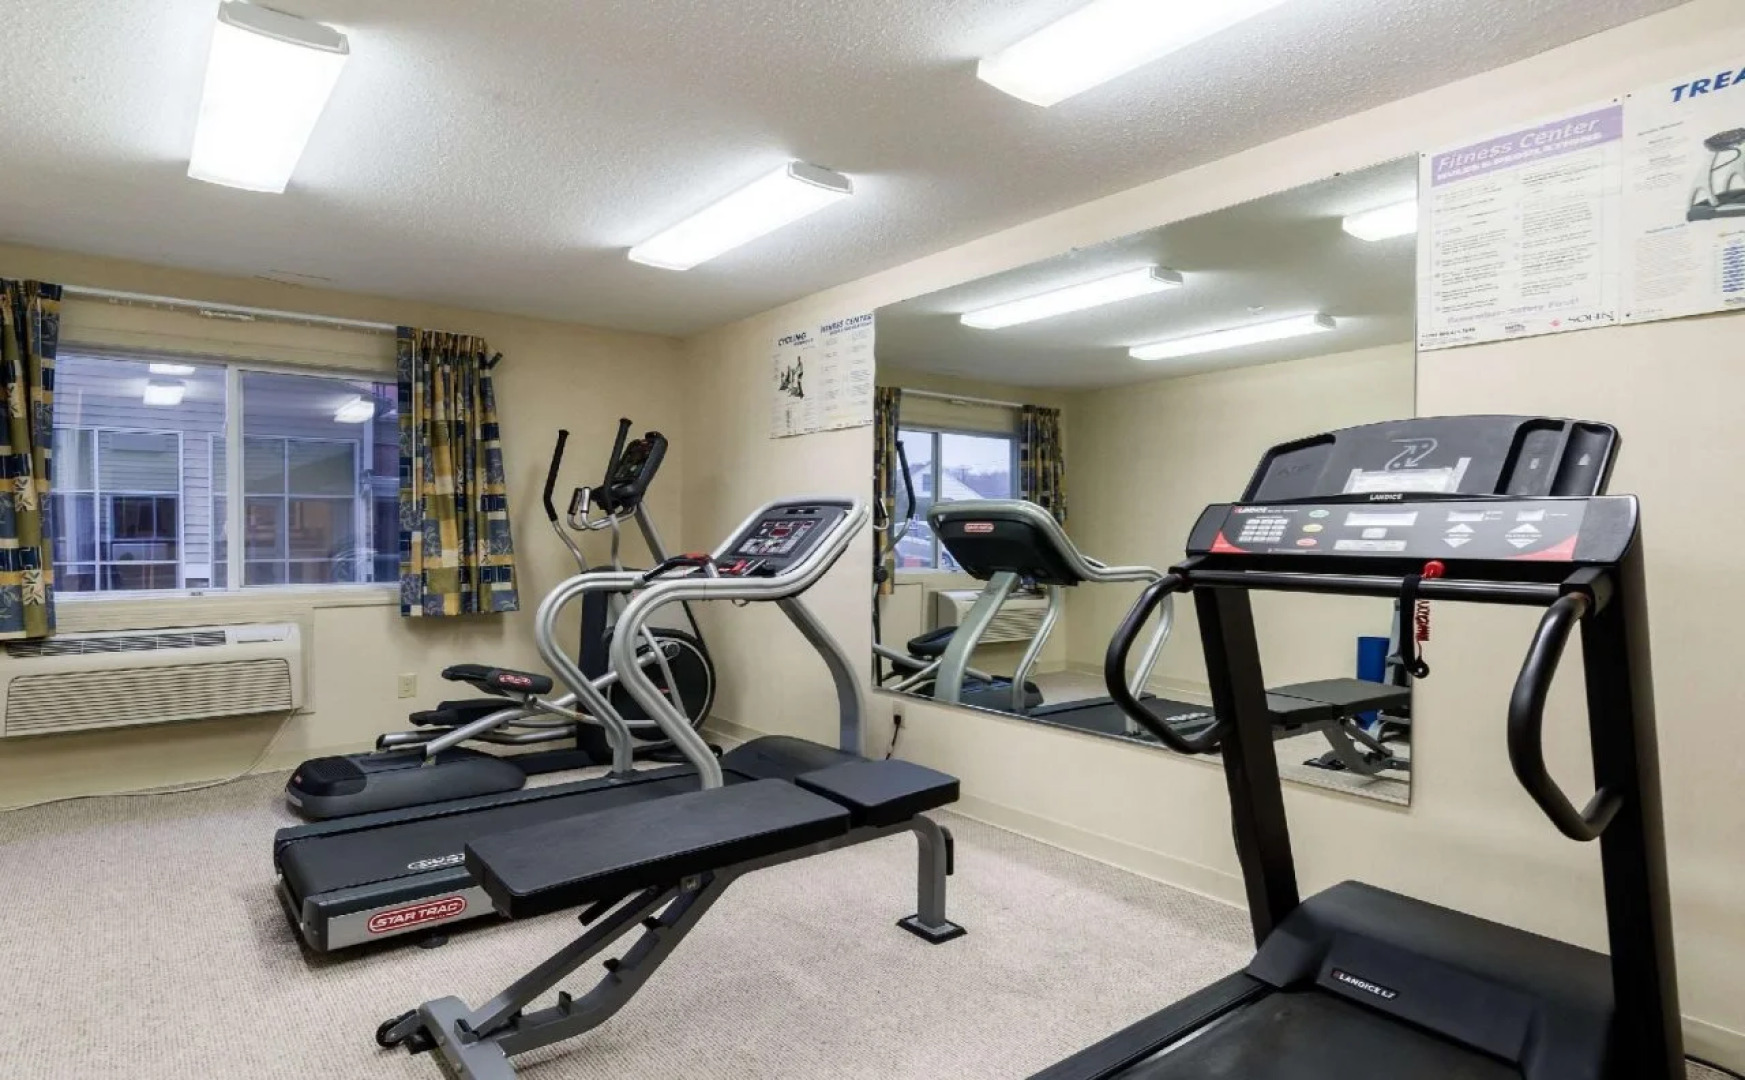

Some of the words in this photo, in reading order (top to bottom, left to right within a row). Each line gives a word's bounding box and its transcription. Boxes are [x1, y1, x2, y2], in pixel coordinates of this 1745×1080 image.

[1439, 142, 1512, 171] Fitness
[1519, 119, 1599, 148] Center
[1370, 493, 1403, 501] LANDICE
[377, 912, 416, 927] STAR
[418, 904, 458, 917] TRAC
[1339, 973, 1381, 994] LANDICE
